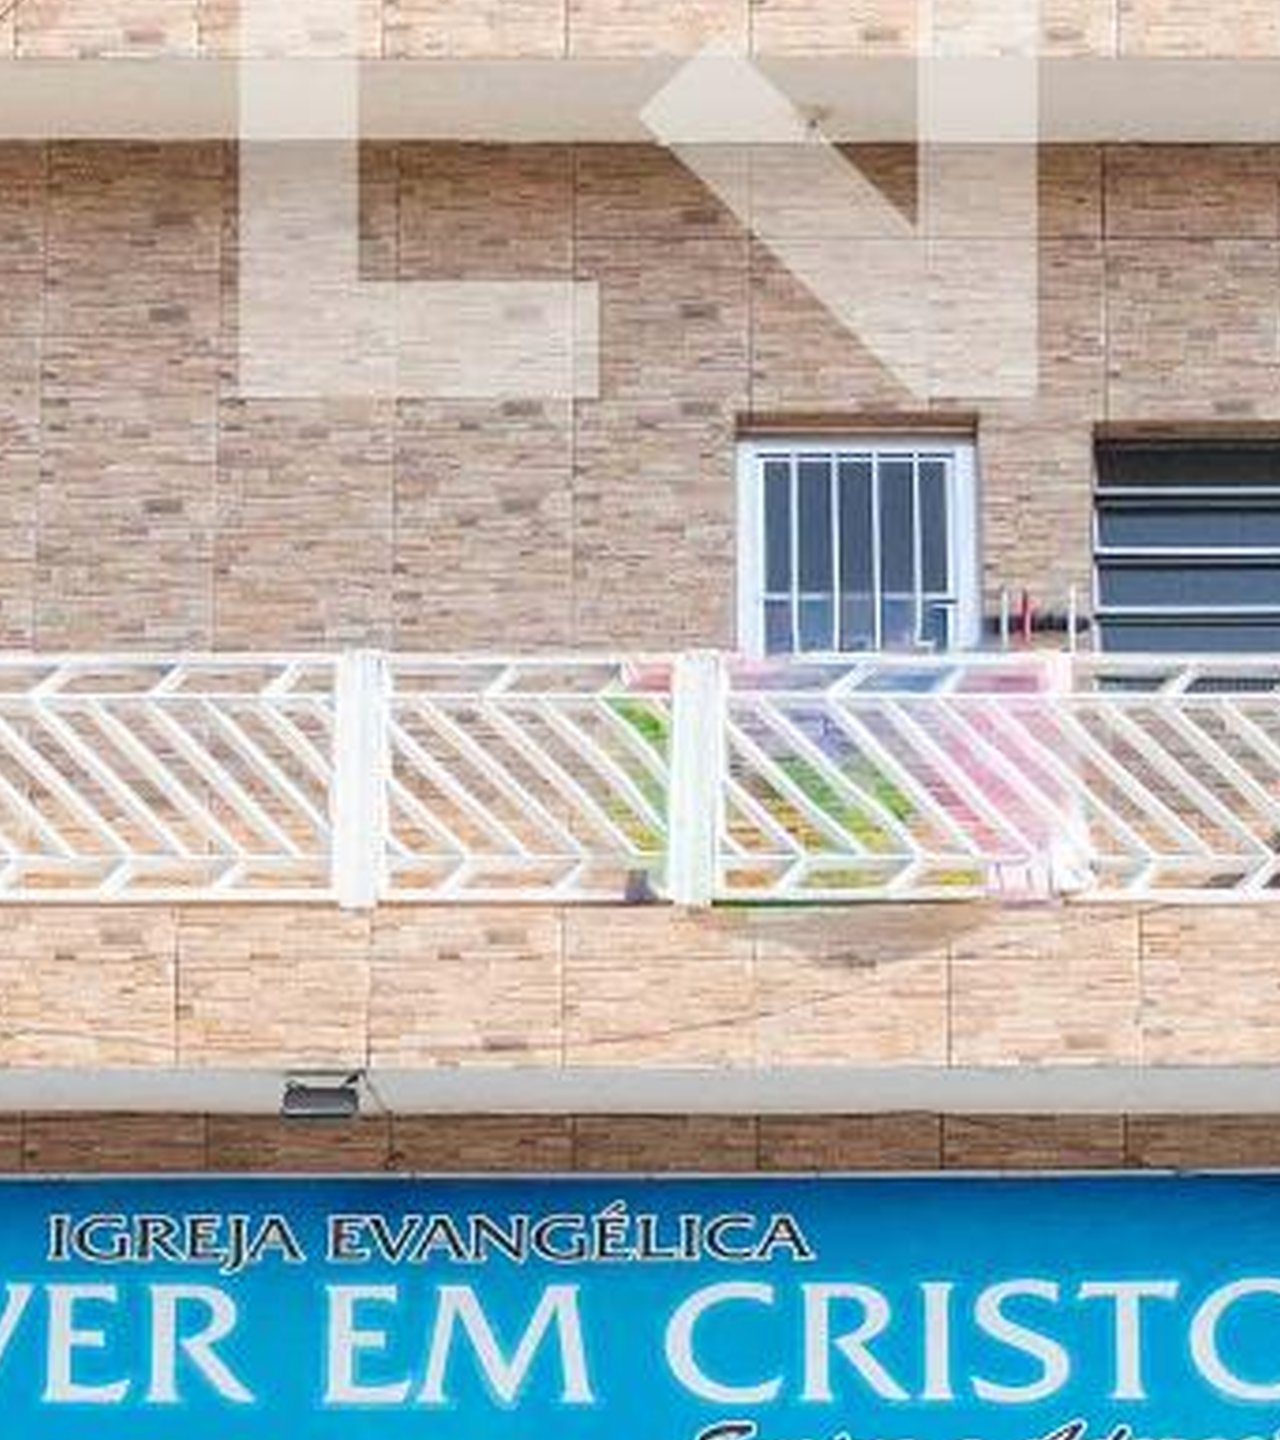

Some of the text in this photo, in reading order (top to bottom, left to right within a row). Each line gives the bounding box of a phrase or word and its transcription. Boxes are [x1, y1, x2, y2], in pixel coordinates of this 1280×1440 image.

[47, 1199, 815, 1276] IGREJA EVANGÉLICA
[324, 1281, 597, 1405] EM
